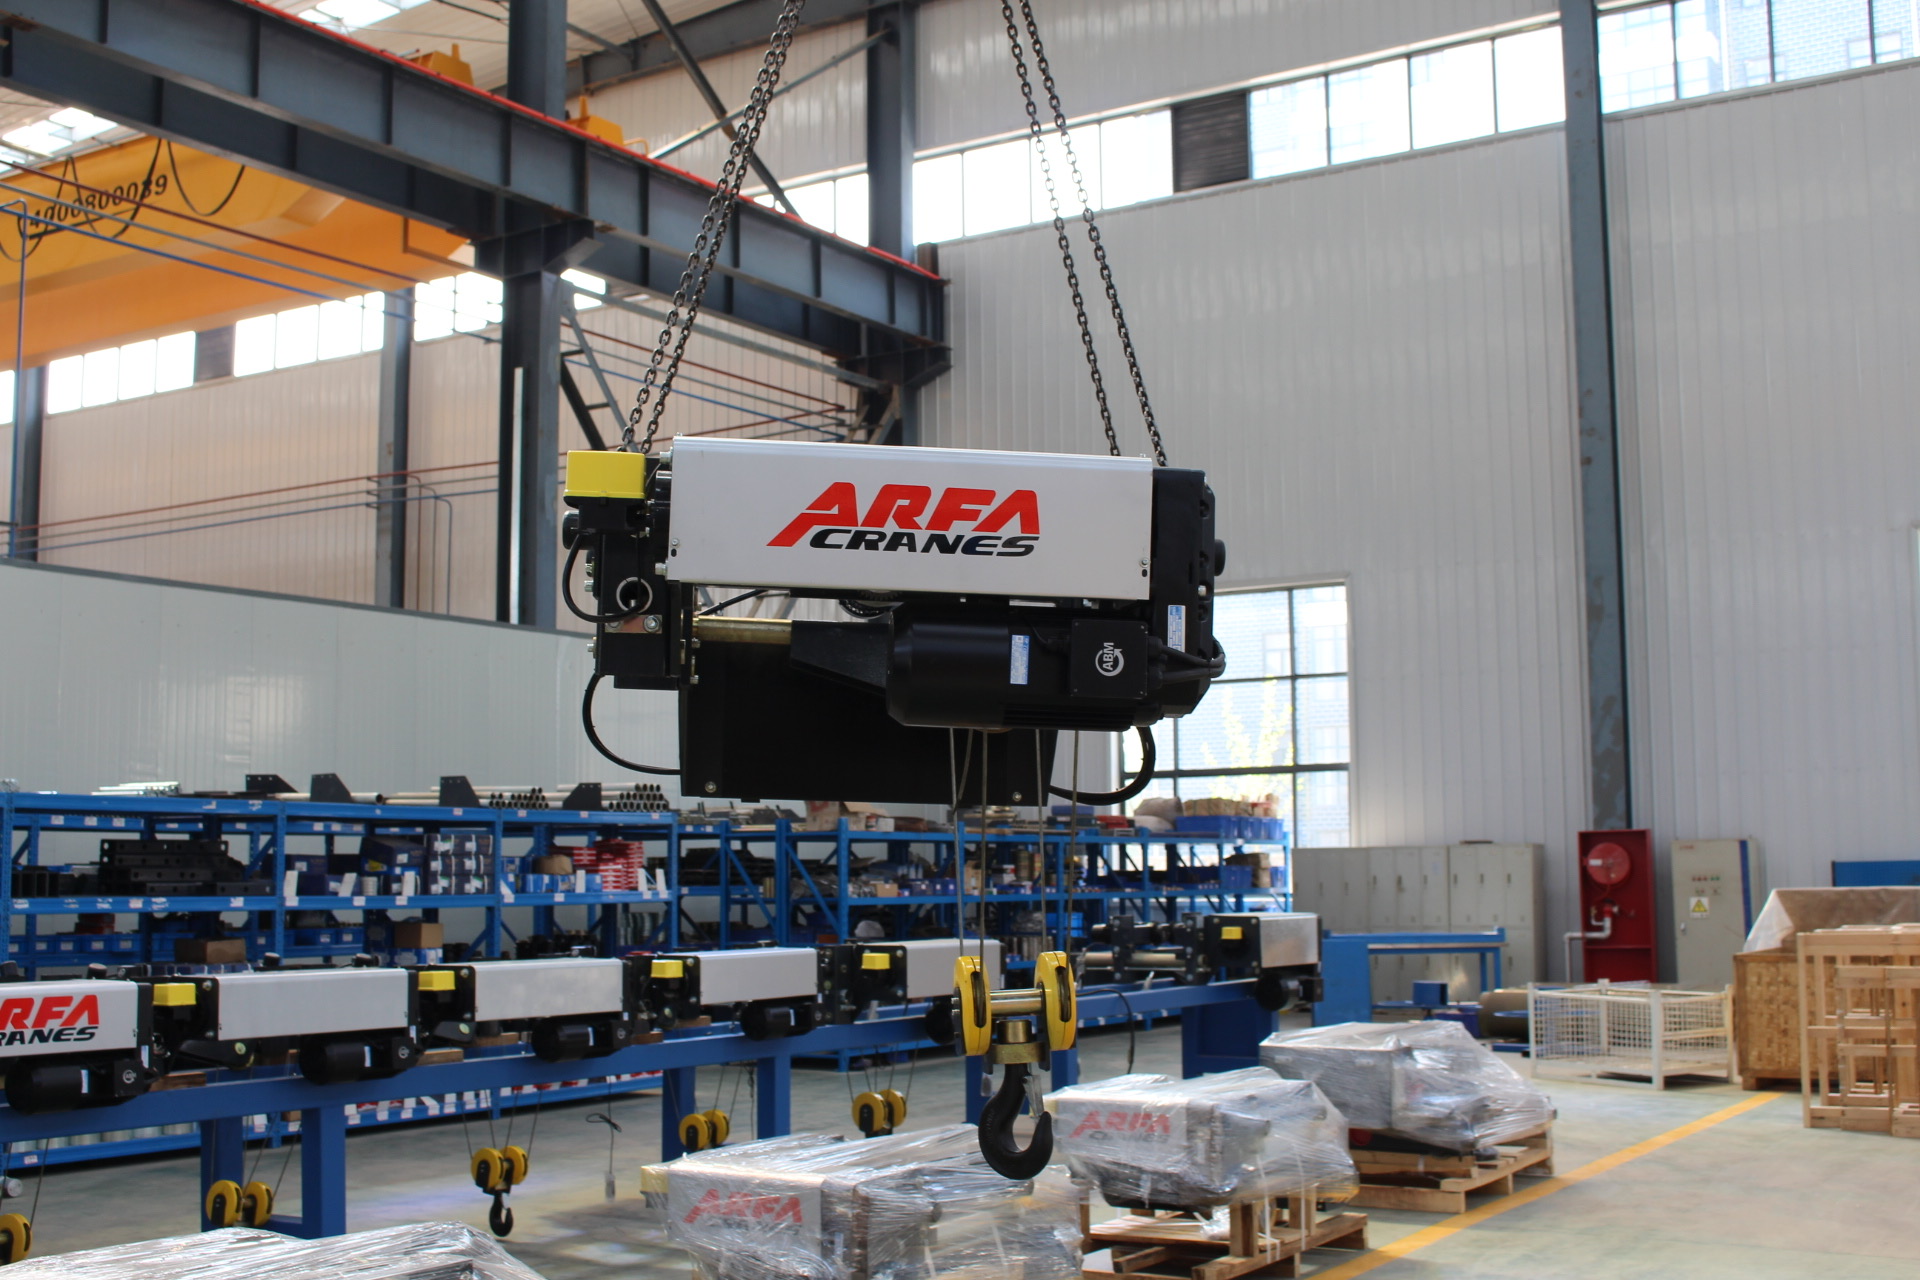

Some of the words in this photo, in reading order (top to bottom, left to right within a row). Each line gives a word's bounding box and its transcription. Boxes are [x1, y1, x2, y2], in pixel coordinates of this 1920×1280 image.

[766, 481, 1040, 547] ARFA
[809, 528, 1040, 557] CRANES
[1102, 642, 1115, 671] ABM
[0, 1026, 99, 1046] ANES
[1068, 1110, 1171, 1138] ARFA
[683, 1188, 803, 1224] ARFA
